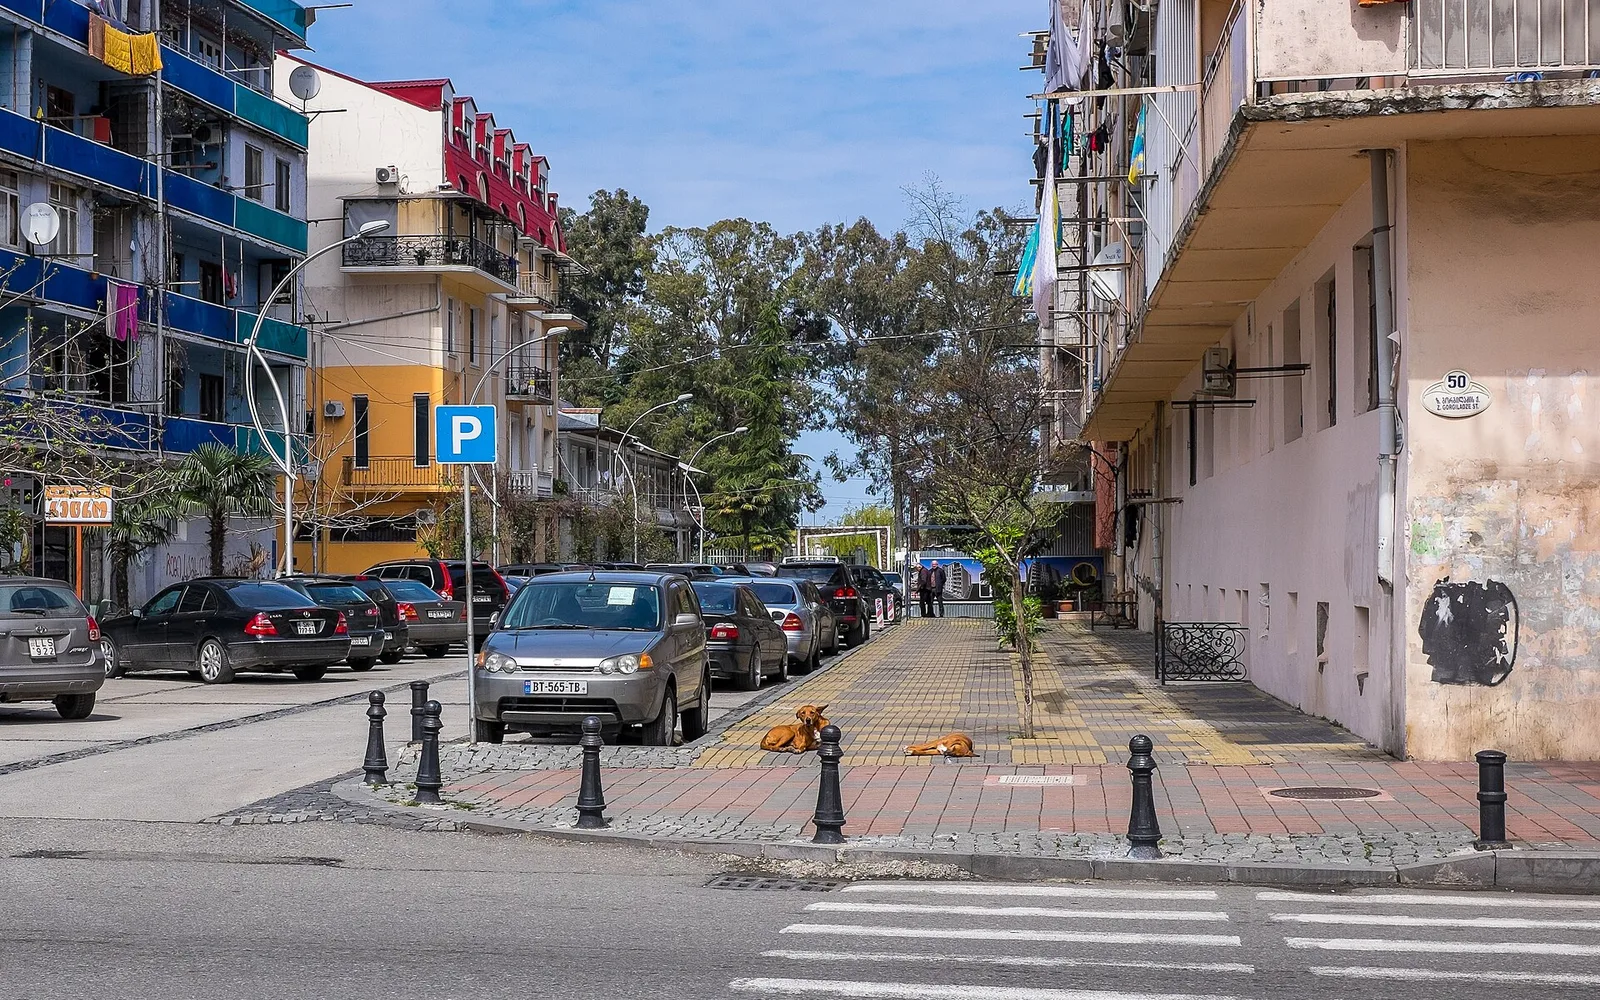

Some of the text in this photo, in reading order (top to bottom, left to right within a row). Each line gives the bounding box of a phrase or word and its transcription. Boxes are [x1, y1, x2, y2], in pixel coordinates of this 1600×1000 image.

[1448, 375, 1466, 388] 50
[452, 415, 482, 454] P
[35, 638, 54, 647] LLS
[36, 647, 54, 656] 922
[533, 681, 580, 692] BT-565-TB
